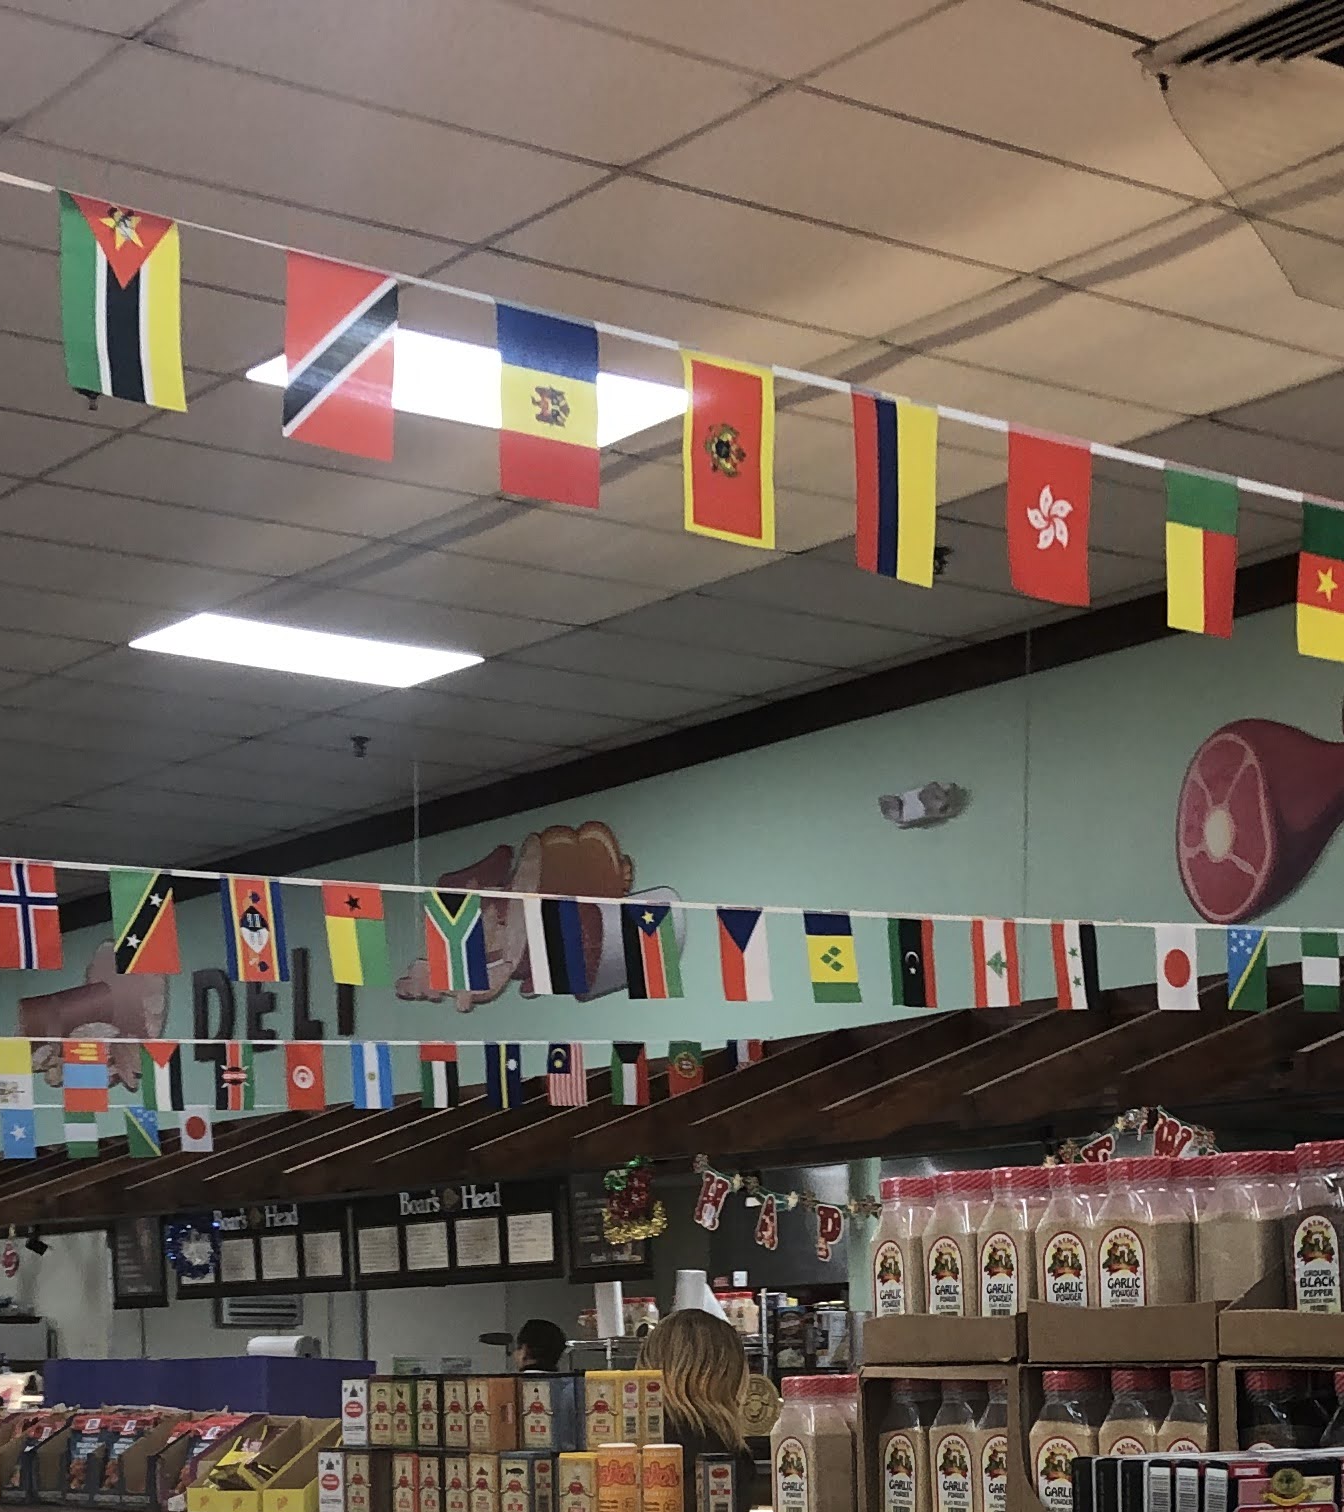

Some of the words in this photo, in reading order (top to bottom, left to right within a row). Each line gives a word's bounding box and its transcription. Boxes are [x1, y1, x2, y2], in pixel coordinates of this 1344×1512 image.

[193, 948, 354, 1061] DELI
[399, 1189, 440, 1216] Boar's
[461, 1182, 501, 1210] Head
[264, 1203, 298, 1228] Head
[1052, 1282, 1083, 1293] GARLIC
[1107, 1277, 1141, 1289] GARLIC
[1300, 1276, 1335, 1288] BLACK
[986, 1283, 1013, 1294] GARLIC
[1045, 1486, 1073, 1497] GARLI
